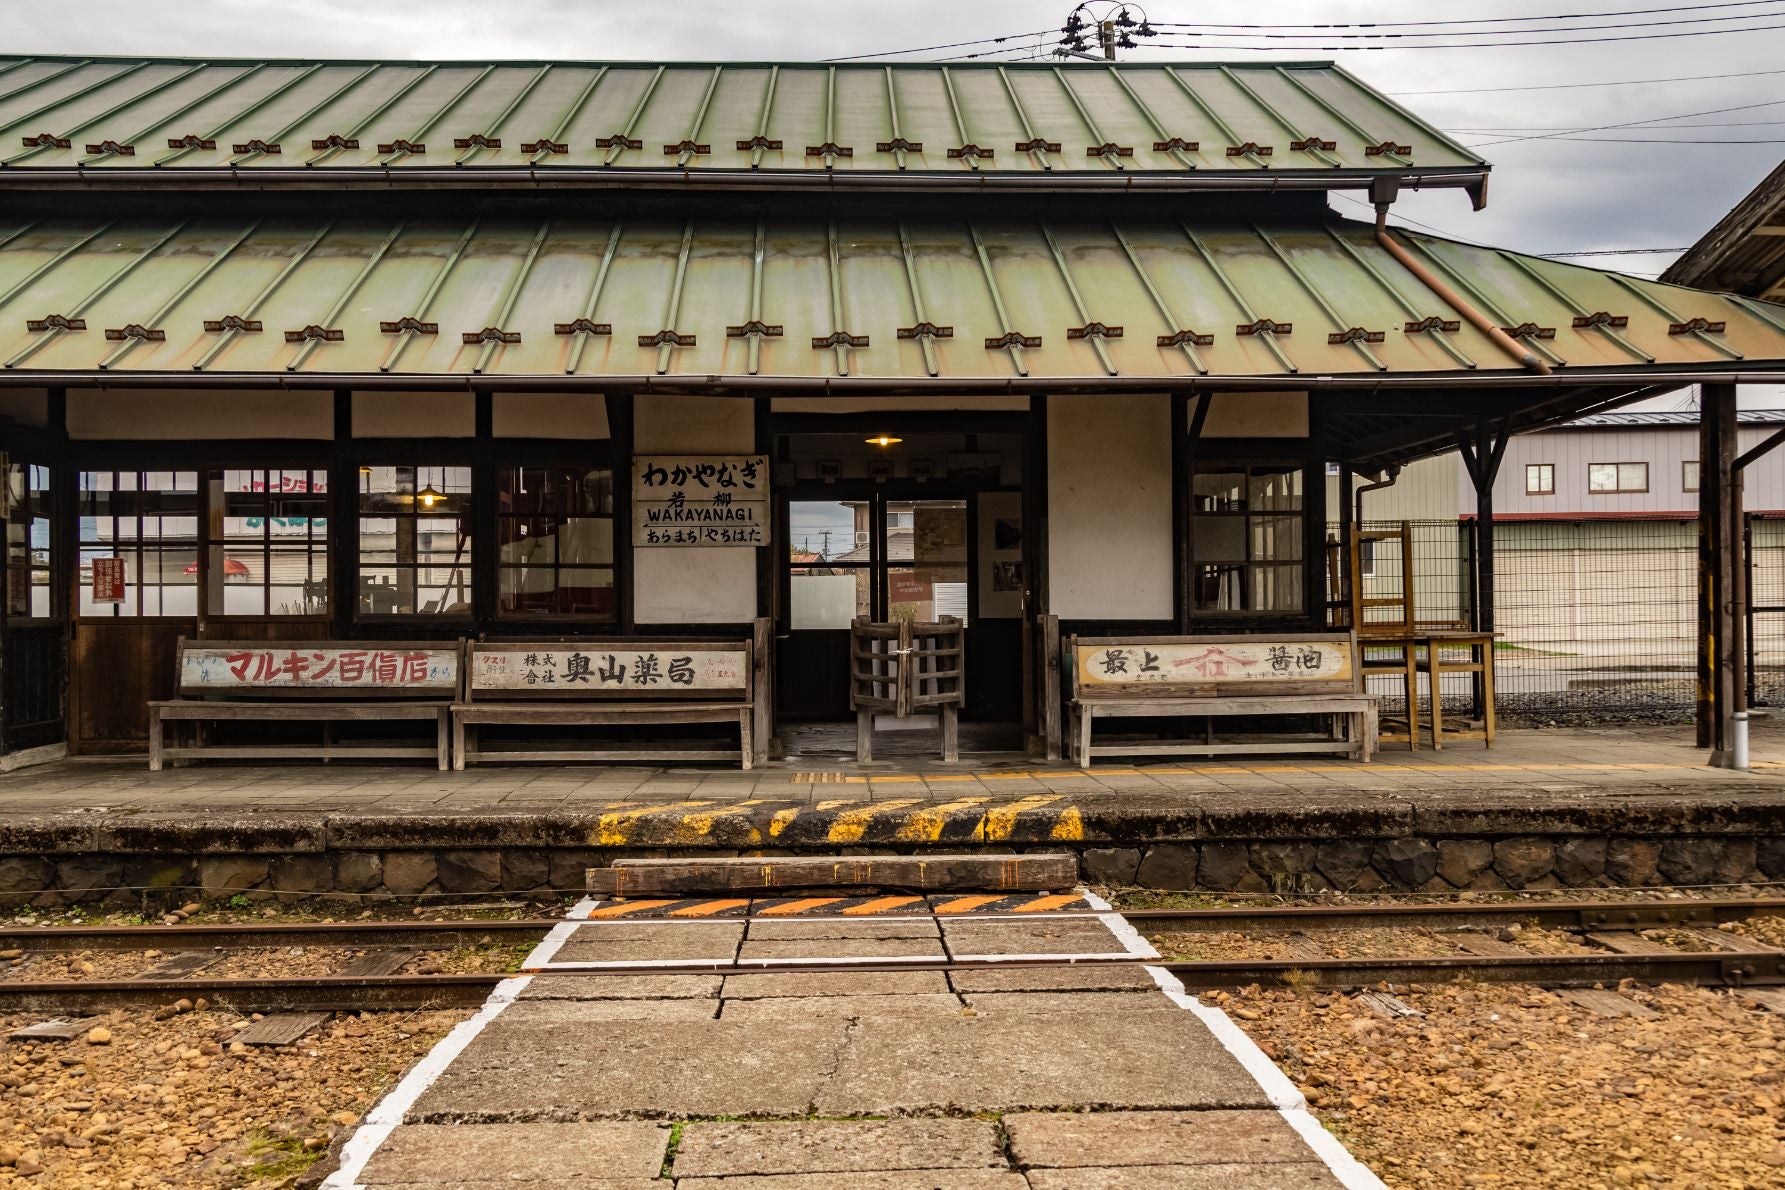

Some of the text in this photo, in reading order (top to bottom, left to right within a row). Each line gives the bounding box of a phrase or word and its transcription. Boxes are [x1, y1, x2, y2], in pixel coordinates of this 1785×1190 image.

[642, 458, 764, 489] わかやなぎ
[647, 507, 752, 522] WAKAYANAGI
[647, 529, 698, 544] あらまち
[705, 528, 761, 543] やちはた
[226, 651, 429, 683] マルキン百貨店
[523, 653, 557, 668] 株式
[1100, 648, 1160, 674] 最上
